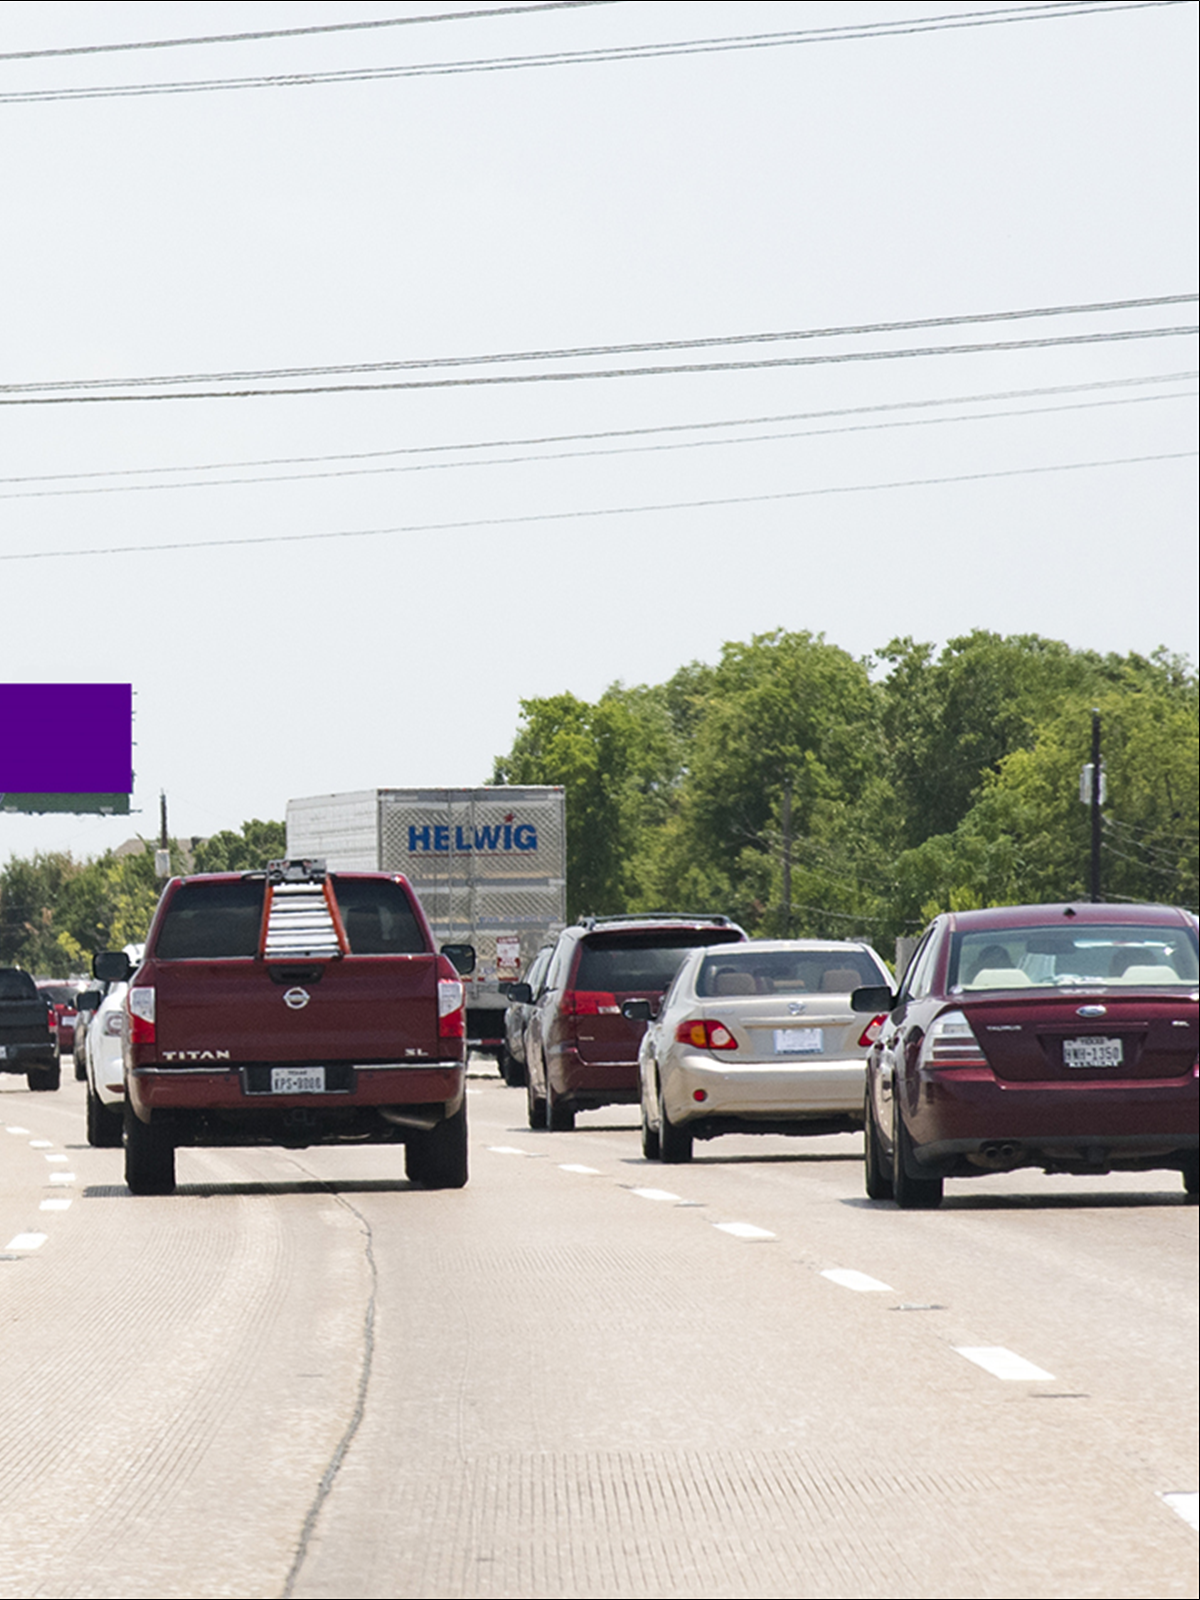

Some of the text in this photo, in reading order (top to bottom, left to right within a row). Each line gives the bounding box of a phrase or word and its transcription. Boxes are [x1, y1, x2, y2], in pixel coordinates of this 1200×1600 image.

[408, 824, 538, 852] HELWIG
[162, 1050, 230, 1061] TITAN
[404, 1048, 429, 1057] SL
